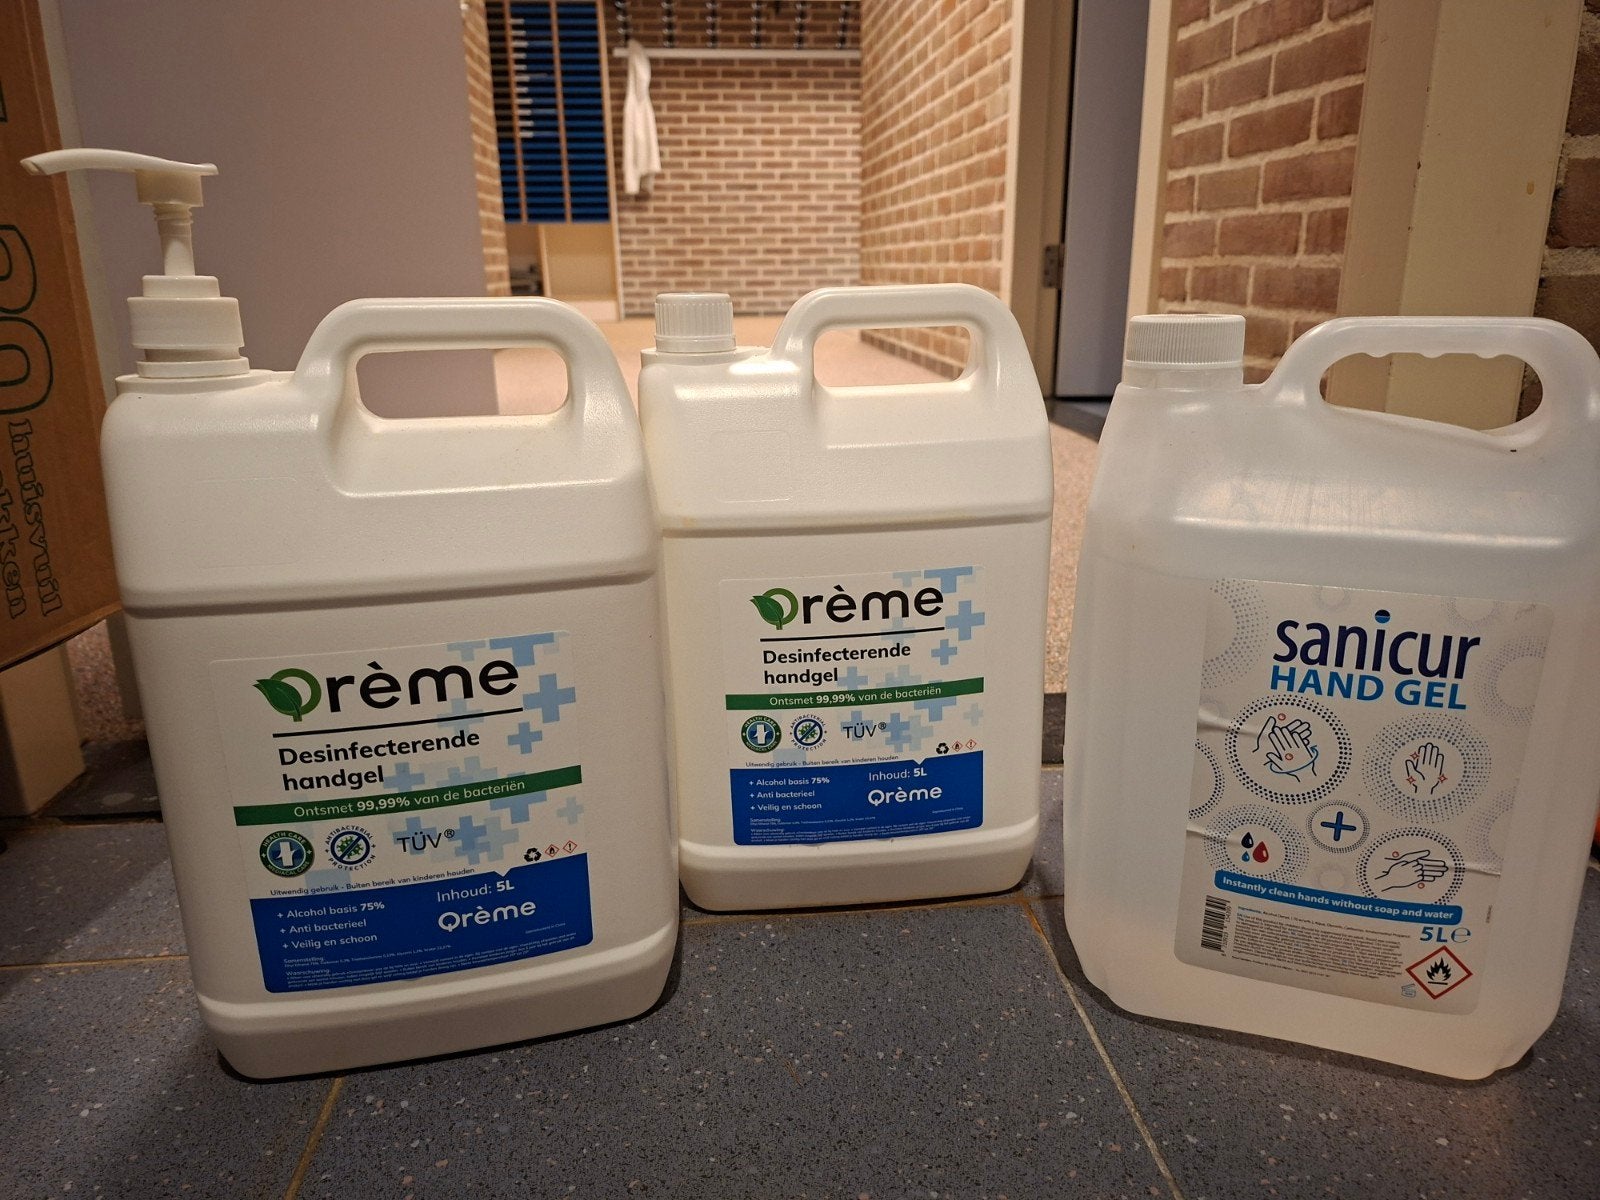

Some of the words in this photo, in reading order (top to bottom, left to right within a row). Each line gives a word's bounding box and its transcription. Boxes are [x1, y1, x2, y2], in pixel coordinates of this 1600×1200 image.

[8, 418, 63, 617] huisvuil
[763, 643, 911, 664] Desinfecterende
[1273, 609, 1481, 679] sanicur
[764, 667, 838, 686] handgel
[769, 696, 813, 706] Ontsmet
[816, 693, 856, 705] 99,99%
[858, 693, 877, 702] van
[880, 690, 893, 699] de
[895, 686, 942, 699] bacteriën
[1270, 665, 1384, 701] HAND
[1394, 679, 1467, 710] GEL
[278, 729, 480, 766] Desinfecterende
[282, 765, 385, 791] handgel
[756, 778, 786, 787] Alcohol
[788, 778, 809, 786] basis
[868, 769, 911, 781] Inhoud:
[913, 767, 928, 777] 5L
[294, 802, 354, 817] Ontsmet
[357, 797, 410, 812] 99,99%
[414, 793, 439, 805] van
[443, 790, 460, 801] de
[463, 780, 526, 799] bacteriën
[775, 790, 815, 798] bacterieel
[867, 786, 942, 806] Qrème
[757, 804, 780, 812] Veilig
[262, 831, 286, 848] HEALTH
[287, 831, 307, 844] CARE
[325, 825, 374, 845] ANTIBACTERIAL
[328, 854, 376, 871] PROTECTION
[270, 887, 309, 897] Uitwendig
[310, 885, 339, 895] gebruik
[346, 881, 370, 890] Buiten
[371, 878, 396, 887] bereik
[397, 876, 411, 884] van
[412, 872, 445, 882] kinderen
[446, 868, 475, 878] houden
[437, 883, 493, 902] Inhoud:
[496, 879, 515, 892] 5L
[1223, 876, 1267, 894] Instantly
[1268, 887, 1296, 899] clean
[1297, 891, 1329, 905] hands
[1331, 899, 1373, 911] without
[1374, 906, 1400, 917] soap
[1402, 908, 1422, 918] and
[1424, 911, 1454, 920] water
[286, 907, 327, 919] Alcohol
[329, 905, 358, 915] basis
[360, 901, 386, 912] 75%
[438, 901, 537, 932] Qrème
[289, 923, 312, 934] Anti
[314, 918, 367, 932] bacterieel
[291, 938, 321, 950] Veilig
[324, 938, 337, 947] en
[340, 933, 378, 945] schoon
